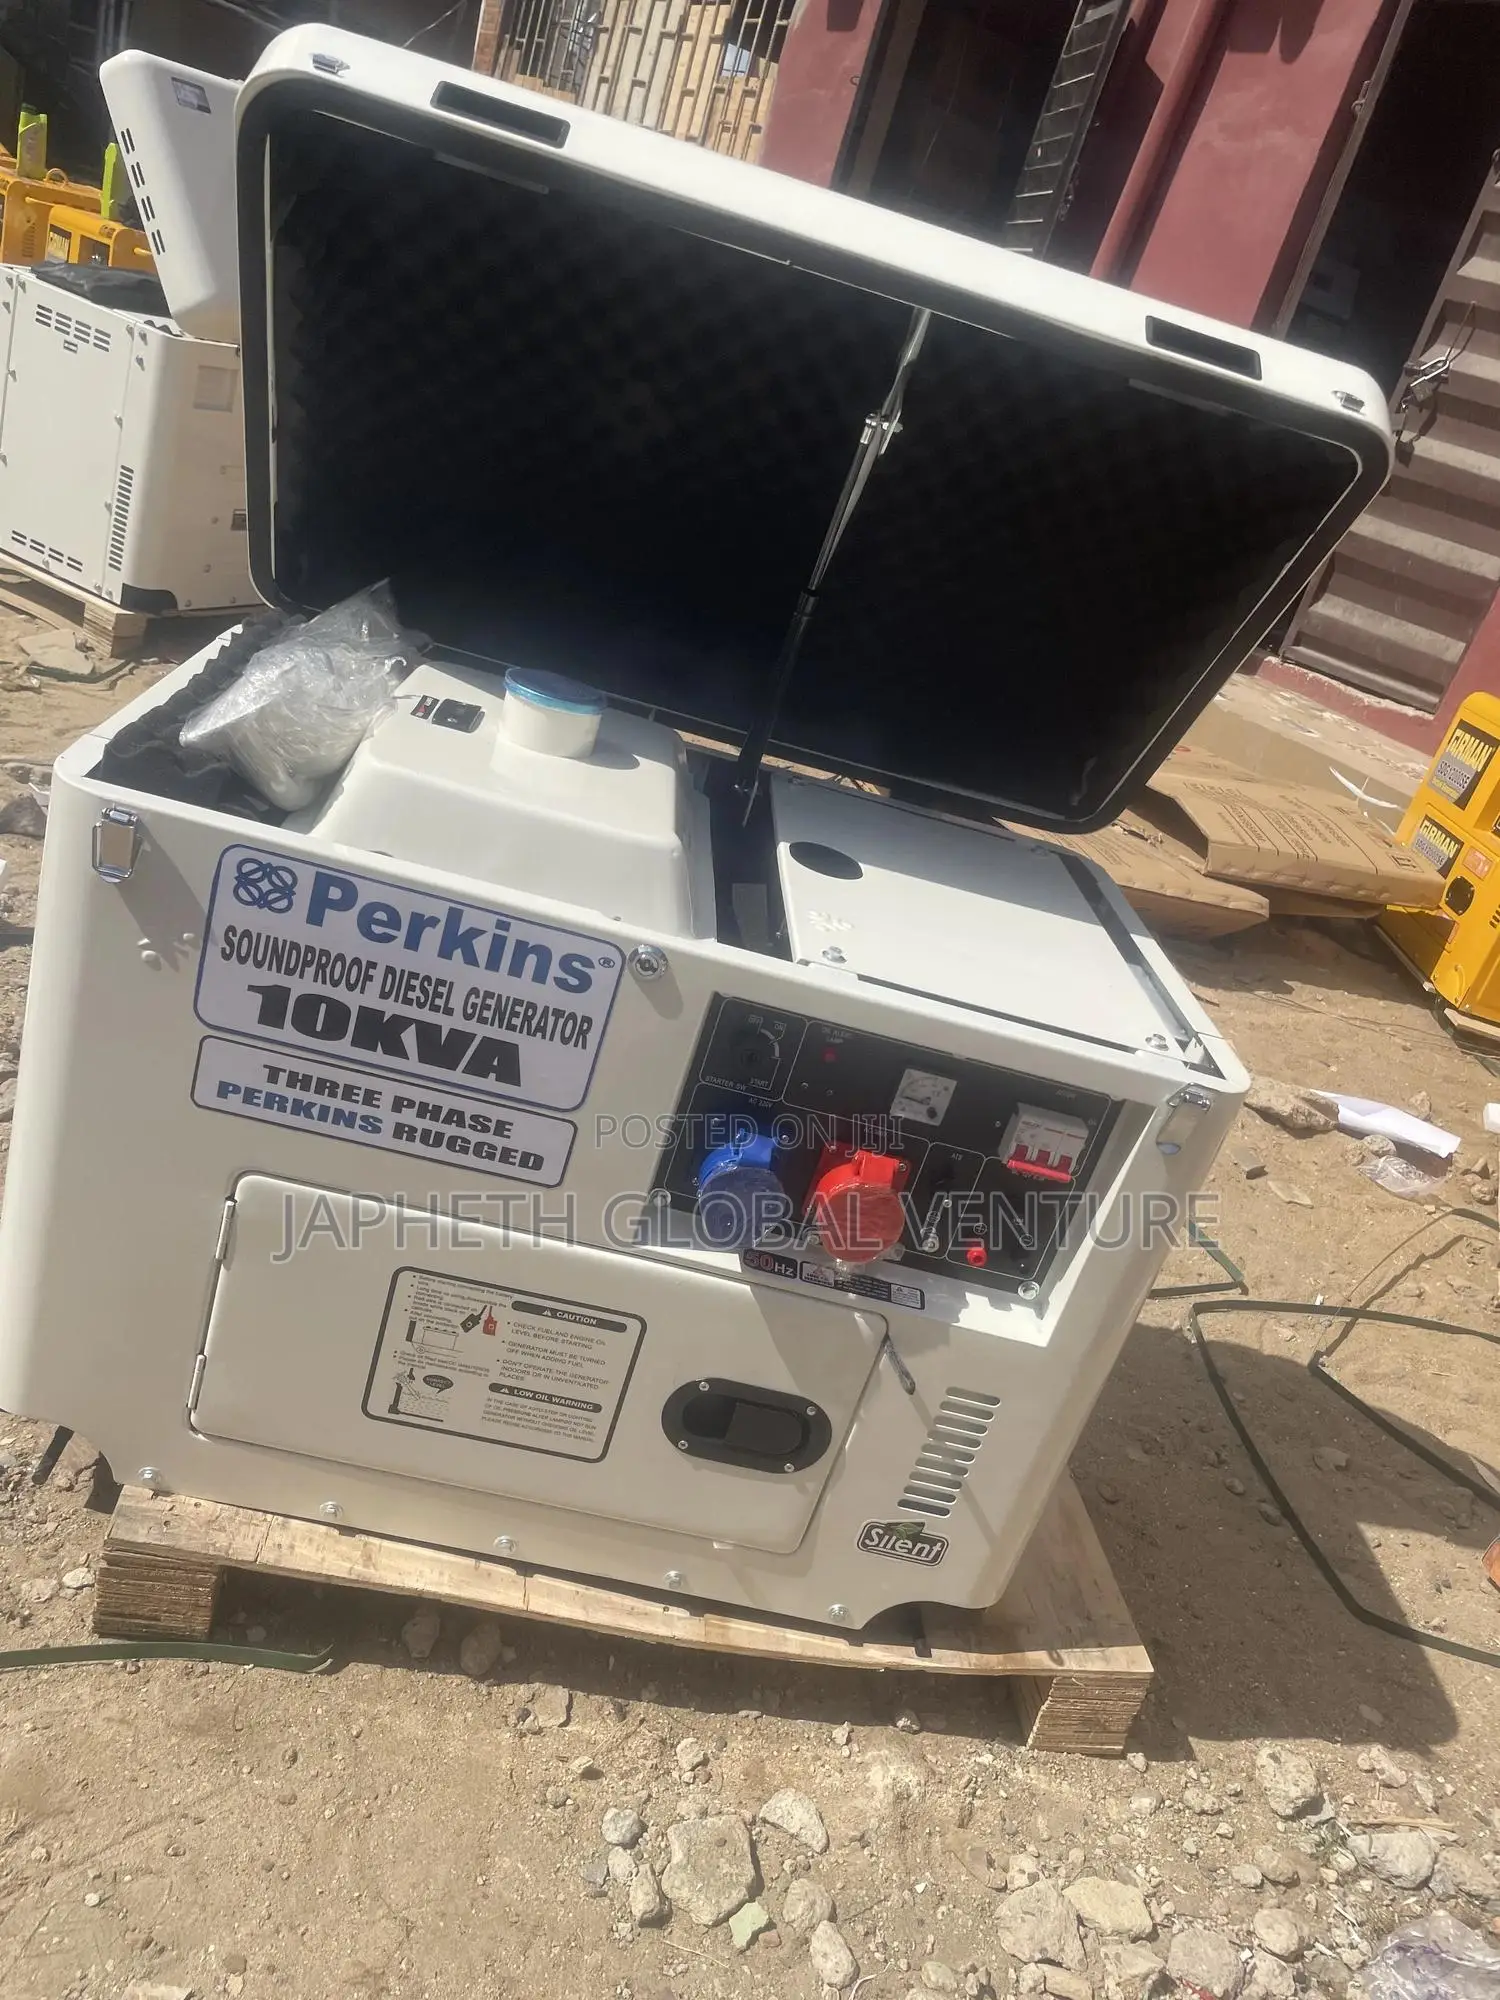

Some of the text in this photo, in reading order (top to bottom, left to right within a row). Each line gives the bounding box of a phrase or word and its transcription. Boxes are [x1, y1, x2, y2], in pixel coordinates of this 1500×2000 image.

[306, 870, 595, 994] Perkins
[220, 924, 593, 1050] SOUNDPROOF DIESEL GENERATOR
[247, 983, 521, 1087] 10KVA
[262, 1064, 514, 1139] THREE PHASE
[216, 1080, 545, 1172] PERKINS RUGGED
[513, 1321, 536, 1332] CHECK
[556, 1311, 597, 1325] CAUTION
[508, 1340, 548, 1354] GENERATOR
[549, 1348, 567, 1358] MUST
[579, 1355, 606, 1366] TURNED
[533, 1333, 559, 1343] BEFORE
[561, 1339, 592, 1350] STARTING
[513, 1388, 594, 1410] LOW OIL WARNING
[865, 1527, 942, 1560] Silent
